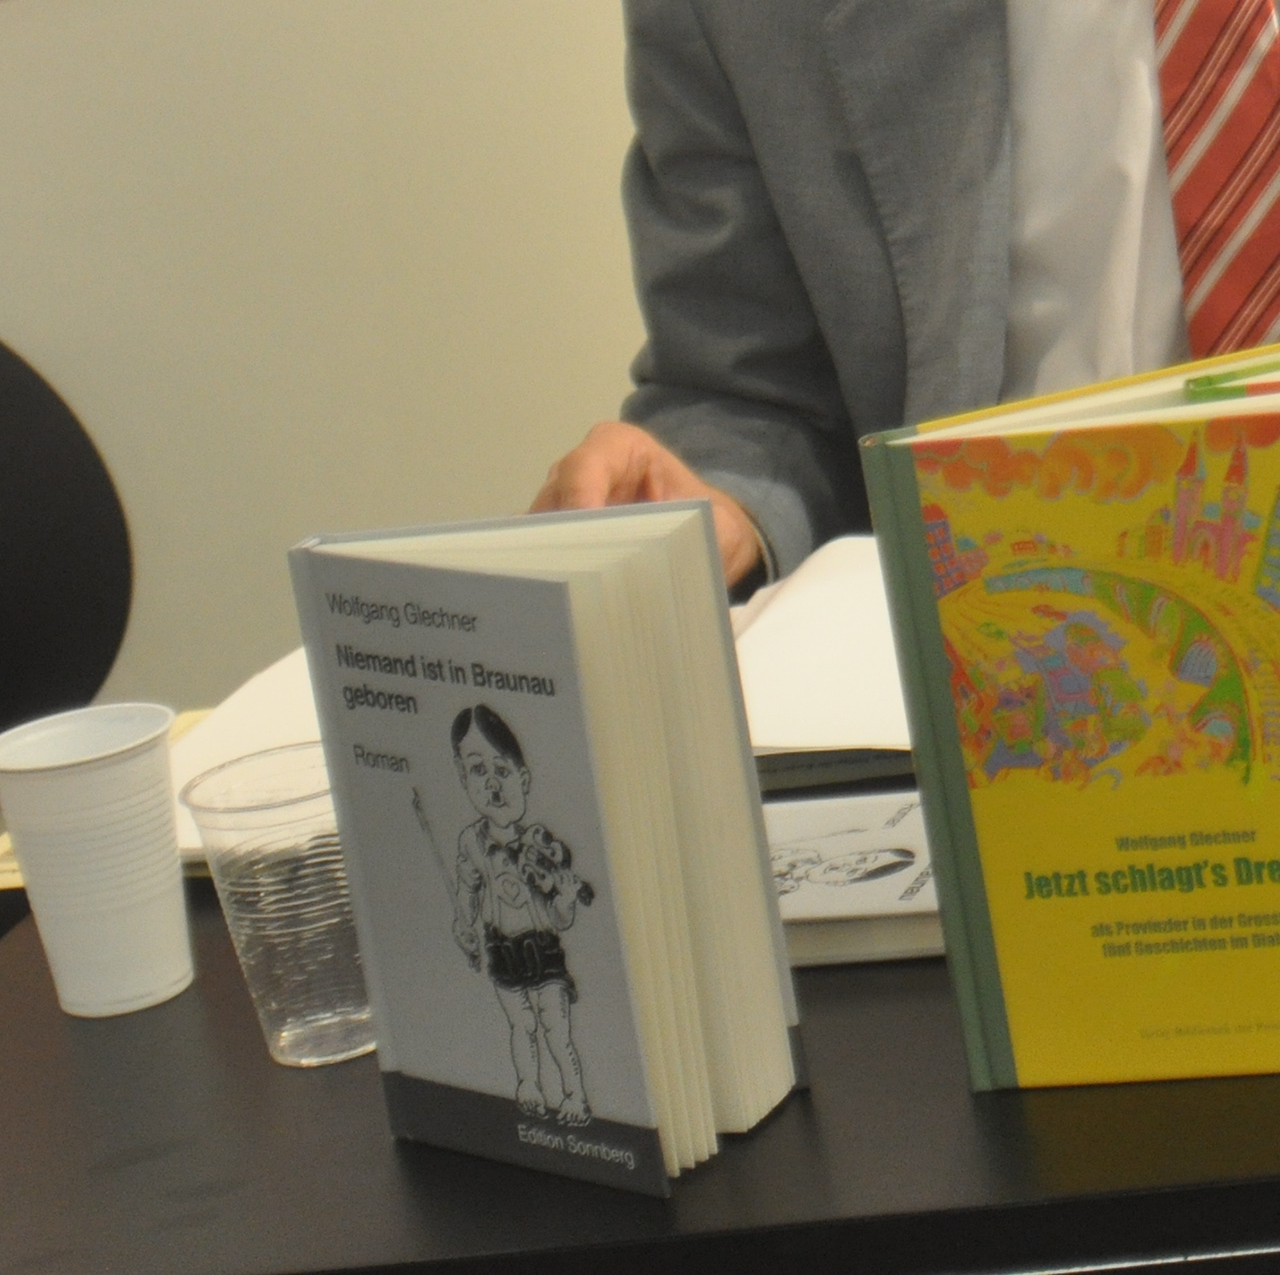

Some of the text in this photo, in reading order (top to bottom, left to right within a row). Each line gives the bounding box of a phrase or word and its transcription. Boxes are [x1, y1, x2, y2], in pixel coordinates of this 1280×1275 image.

[325, 592, 400, 629] Wolfgang
[336, 643, 555, 697] Niemand ist in Braunau
[343, 684, 418, 715] geboren
[353, 743, 410, 774] Roman
[1116, 834, 1187, 852] Wolfgang
[1024, 869, 1090, 900] Jetzt
